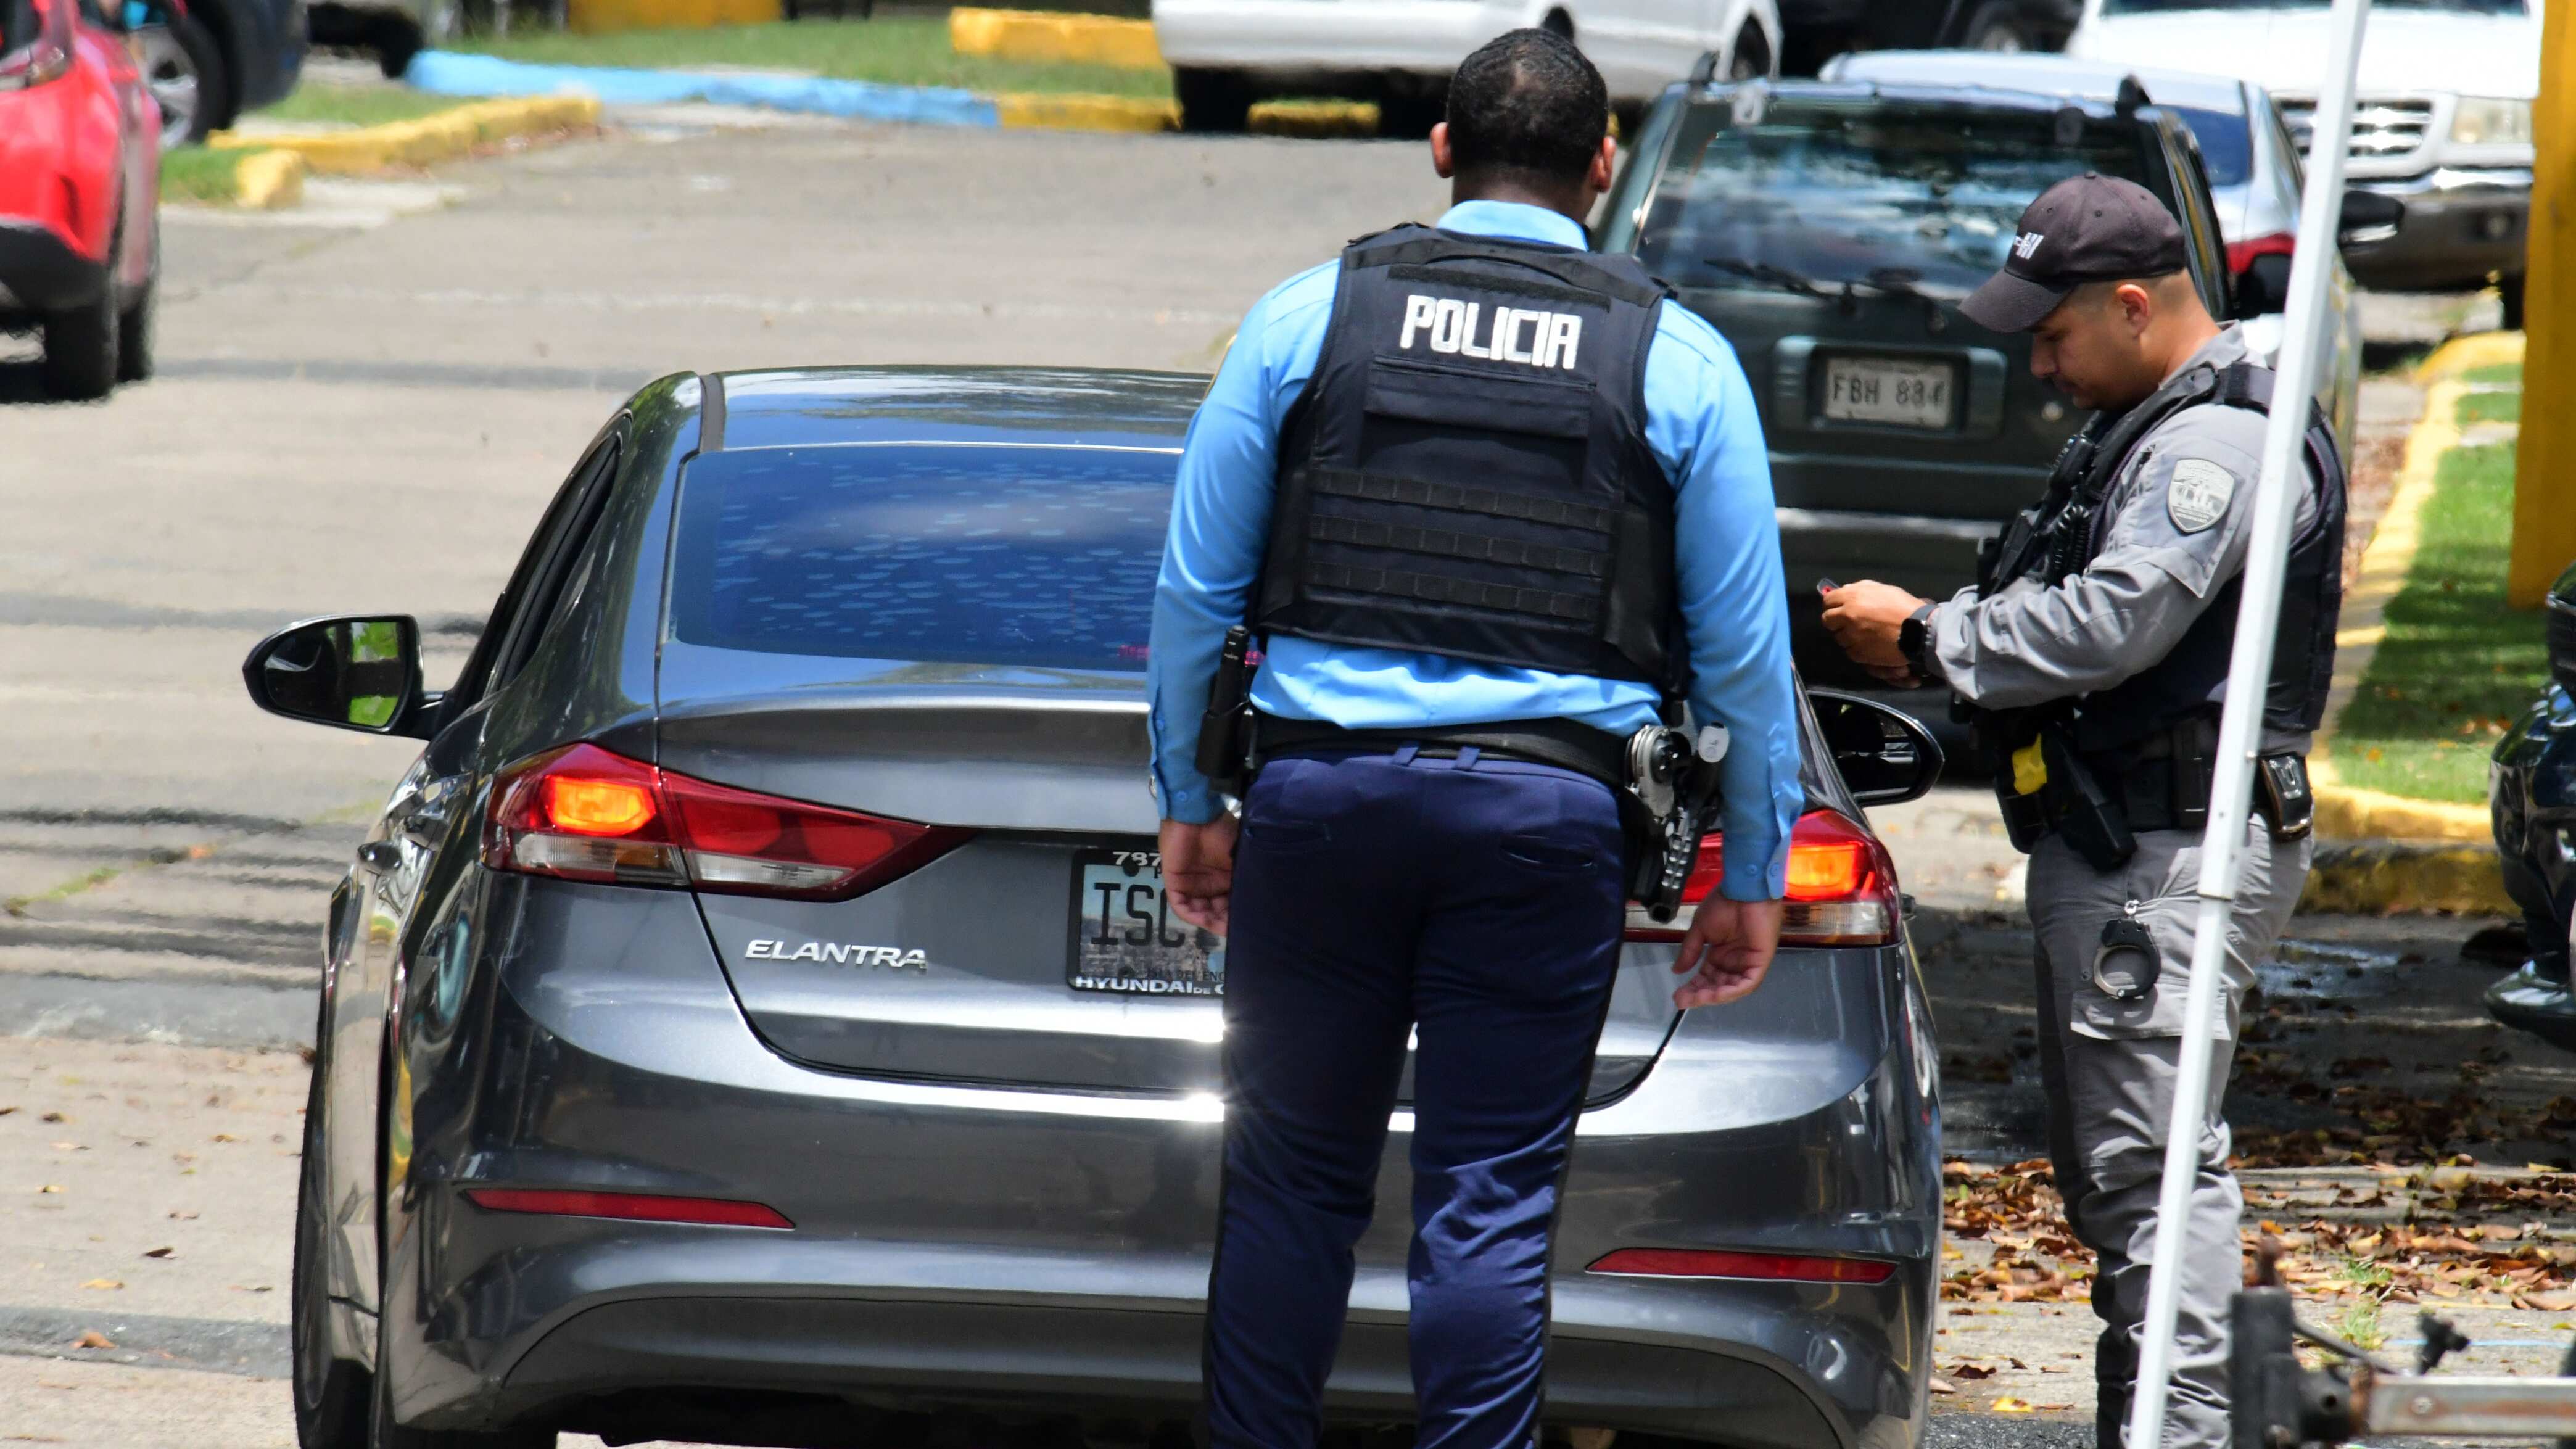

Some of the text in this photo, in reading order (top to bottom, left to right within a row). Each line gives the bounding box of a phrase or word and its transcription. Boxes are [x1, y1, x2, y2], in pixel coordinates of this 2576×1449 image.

[1400, 294, 1583, 369] POLICIA
[1833, 373, 1880, 405] FBH
[1113, 852, 1162, 866] 787
[745, 939, 927, 969] ELANTRA
[1075, 976, 1193, 993] HYUNDAI
